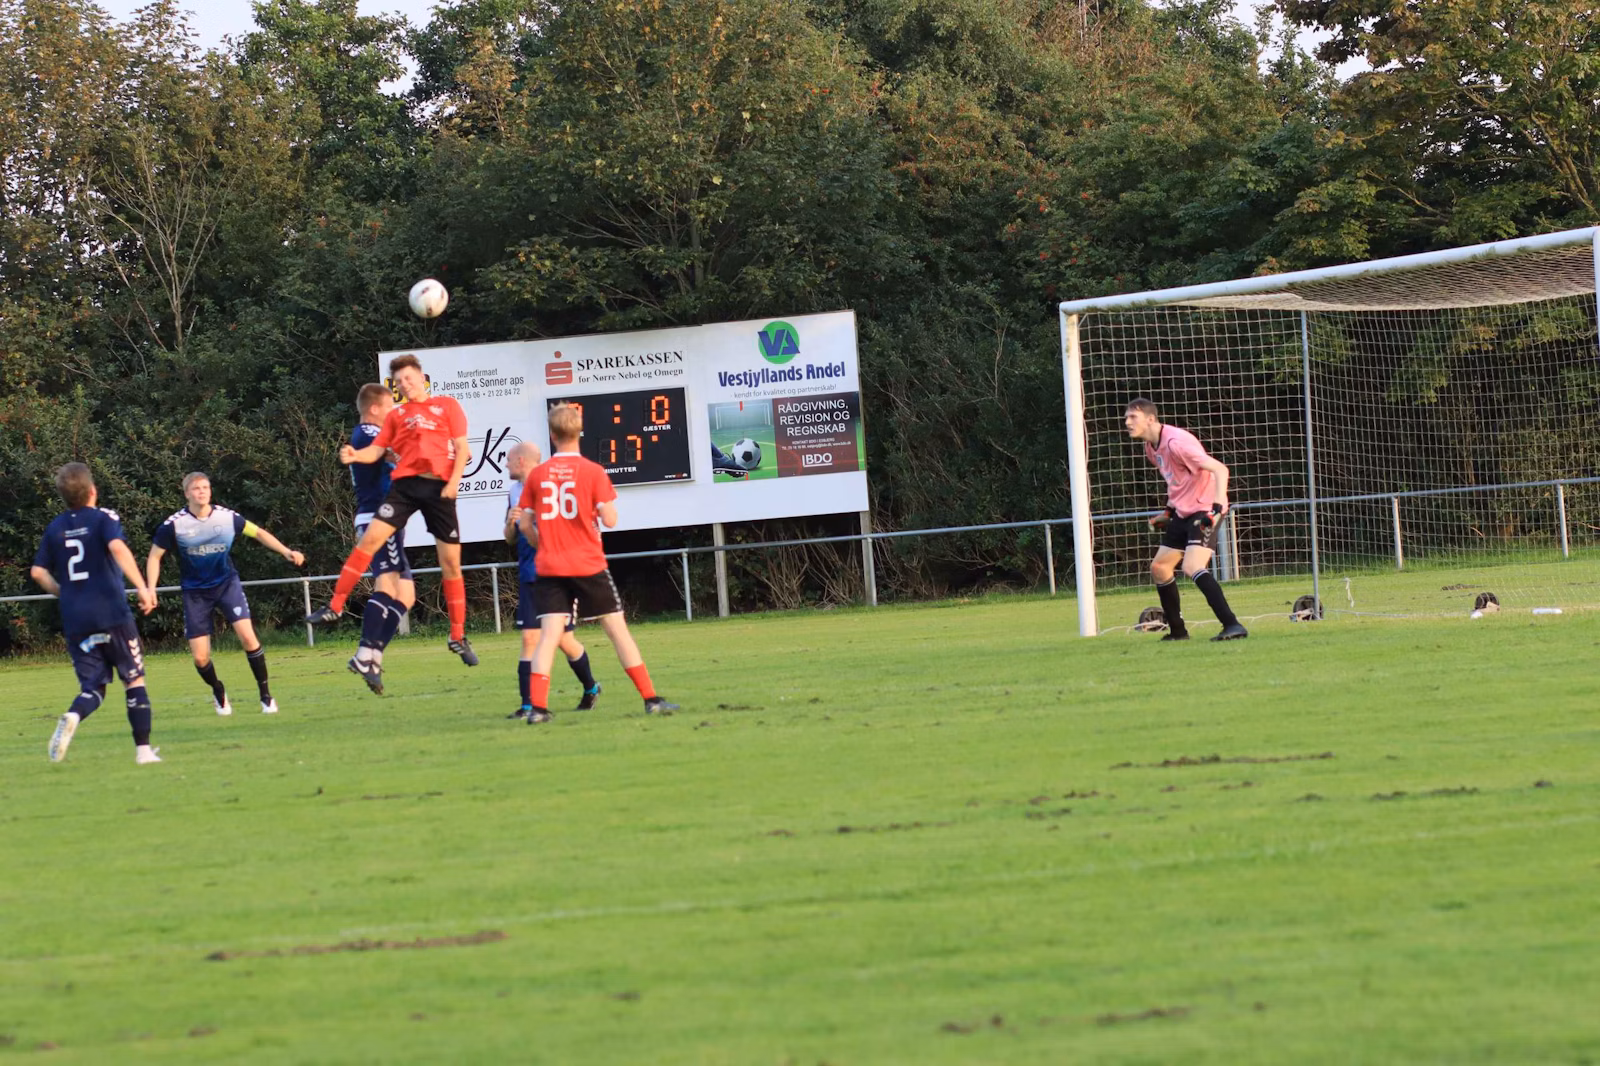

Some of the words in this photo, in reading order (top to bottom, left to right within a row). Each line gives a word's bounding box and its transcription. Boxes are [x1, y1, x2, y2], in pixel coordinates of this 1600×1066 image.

[757, 329, 800, 356] VA
[577, 350, 683, 371] SPAREKASSEN
[457, 368, 498, 378] Murerfirmaet
[578, 375, 591, 383] for
[618, 371, 641, 379] Nebel
[654, 368, 684, 377] Omegn
[718, 366, 803, 388] Vestjyllands
[806, 361, 846, 380] Andel
[433, 381, 440, 391] P.
[441, 381, 470, 391] Jensen
[471, 379, 478, 388] &
[480, 377, 507, 387] Sønner
[510, 376, 524, 386] aps
[651, 395, 669, 425] 0
[780, 412, 831, 425] REVISION
[833, 410, 850, 421] OG
[787, 423, 846, 437] REGNSKAB
[805, 452, 833, 465] BDO
[458, 482, 471, 491] 28
[474, 480, 487, 491] 20
[490, 479, 504, 490] 02
[540, 481, 578, 520] 36
[65, 539, 89, 581] 2
